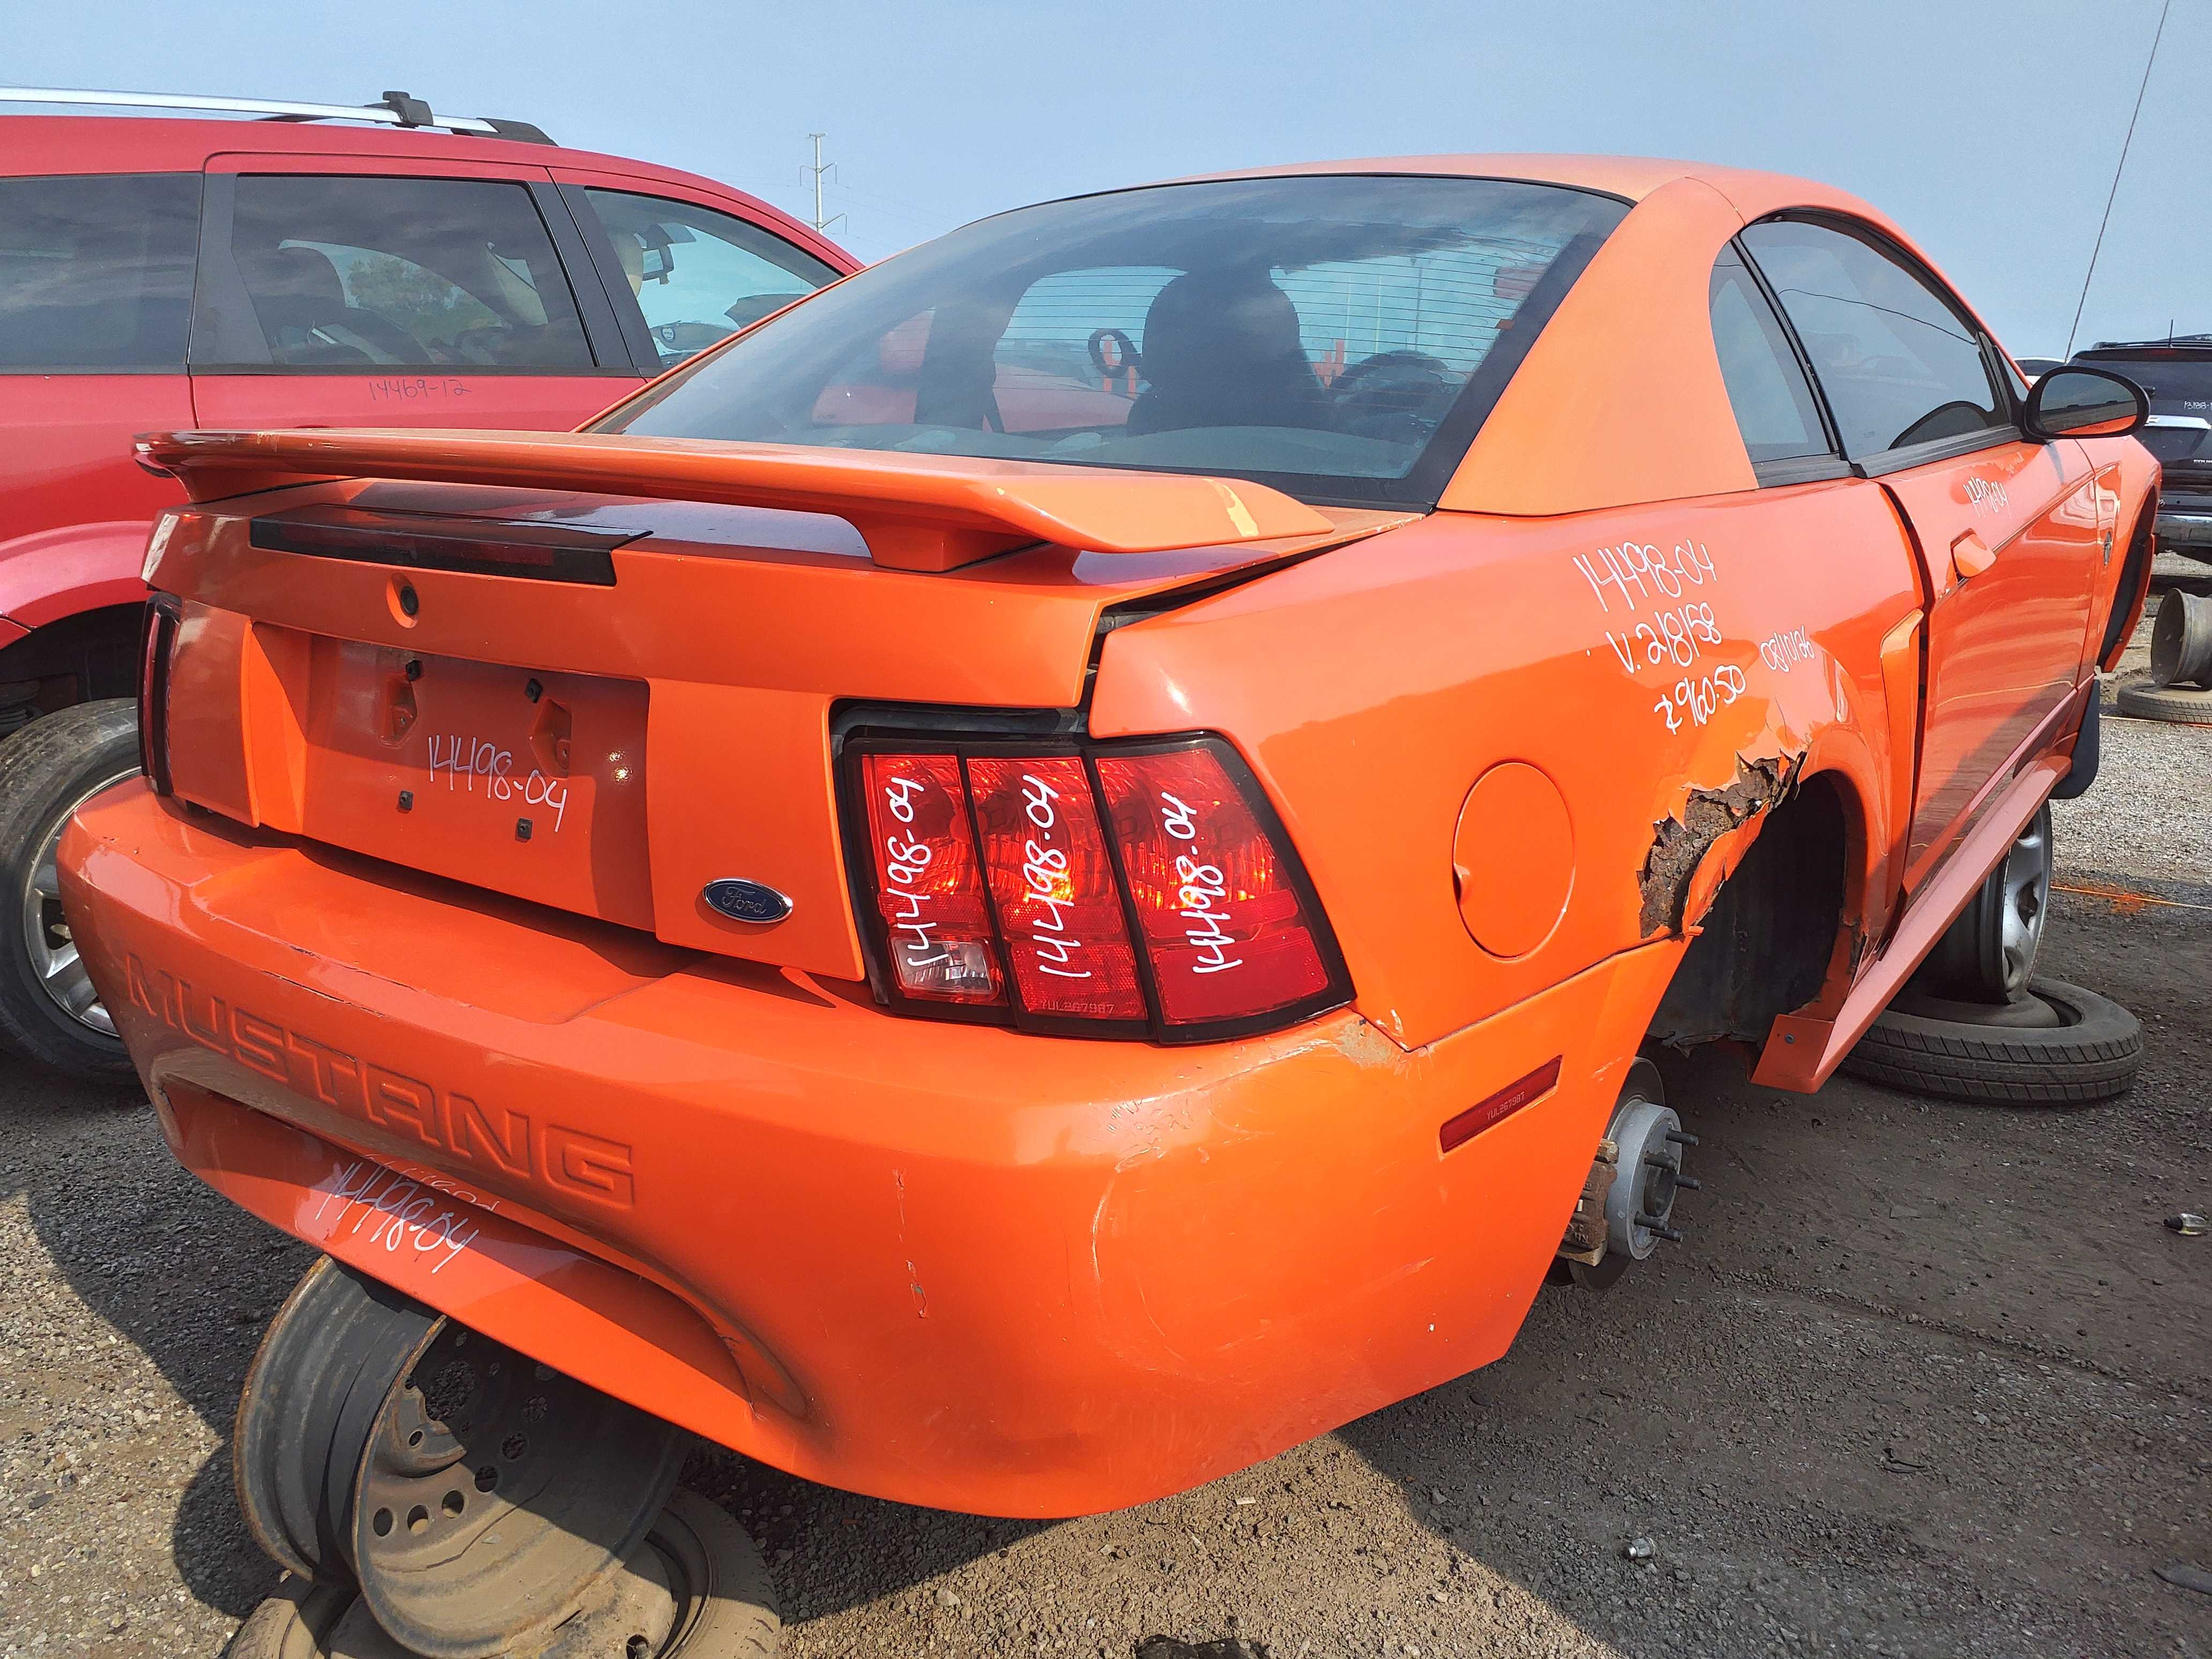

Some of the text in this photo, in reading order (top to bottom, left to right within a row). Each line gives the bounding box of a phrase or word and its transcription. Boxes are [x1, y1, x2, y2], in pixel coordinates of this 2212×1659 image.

[369, 378, 472, 401] 14469-12
[1572, 539, 1717, 612] 14498-04
[428, 735, 568, 832] 14498-04
[722, 886, 767, 914] Ford
[885, 776, 950, 967] 14498-04
[125, 953, 634, 1208] MUSTANG
[1486, 1090, 1526, 1120] YUL267987
[315, 1162, 480, 1274] 14498-04
